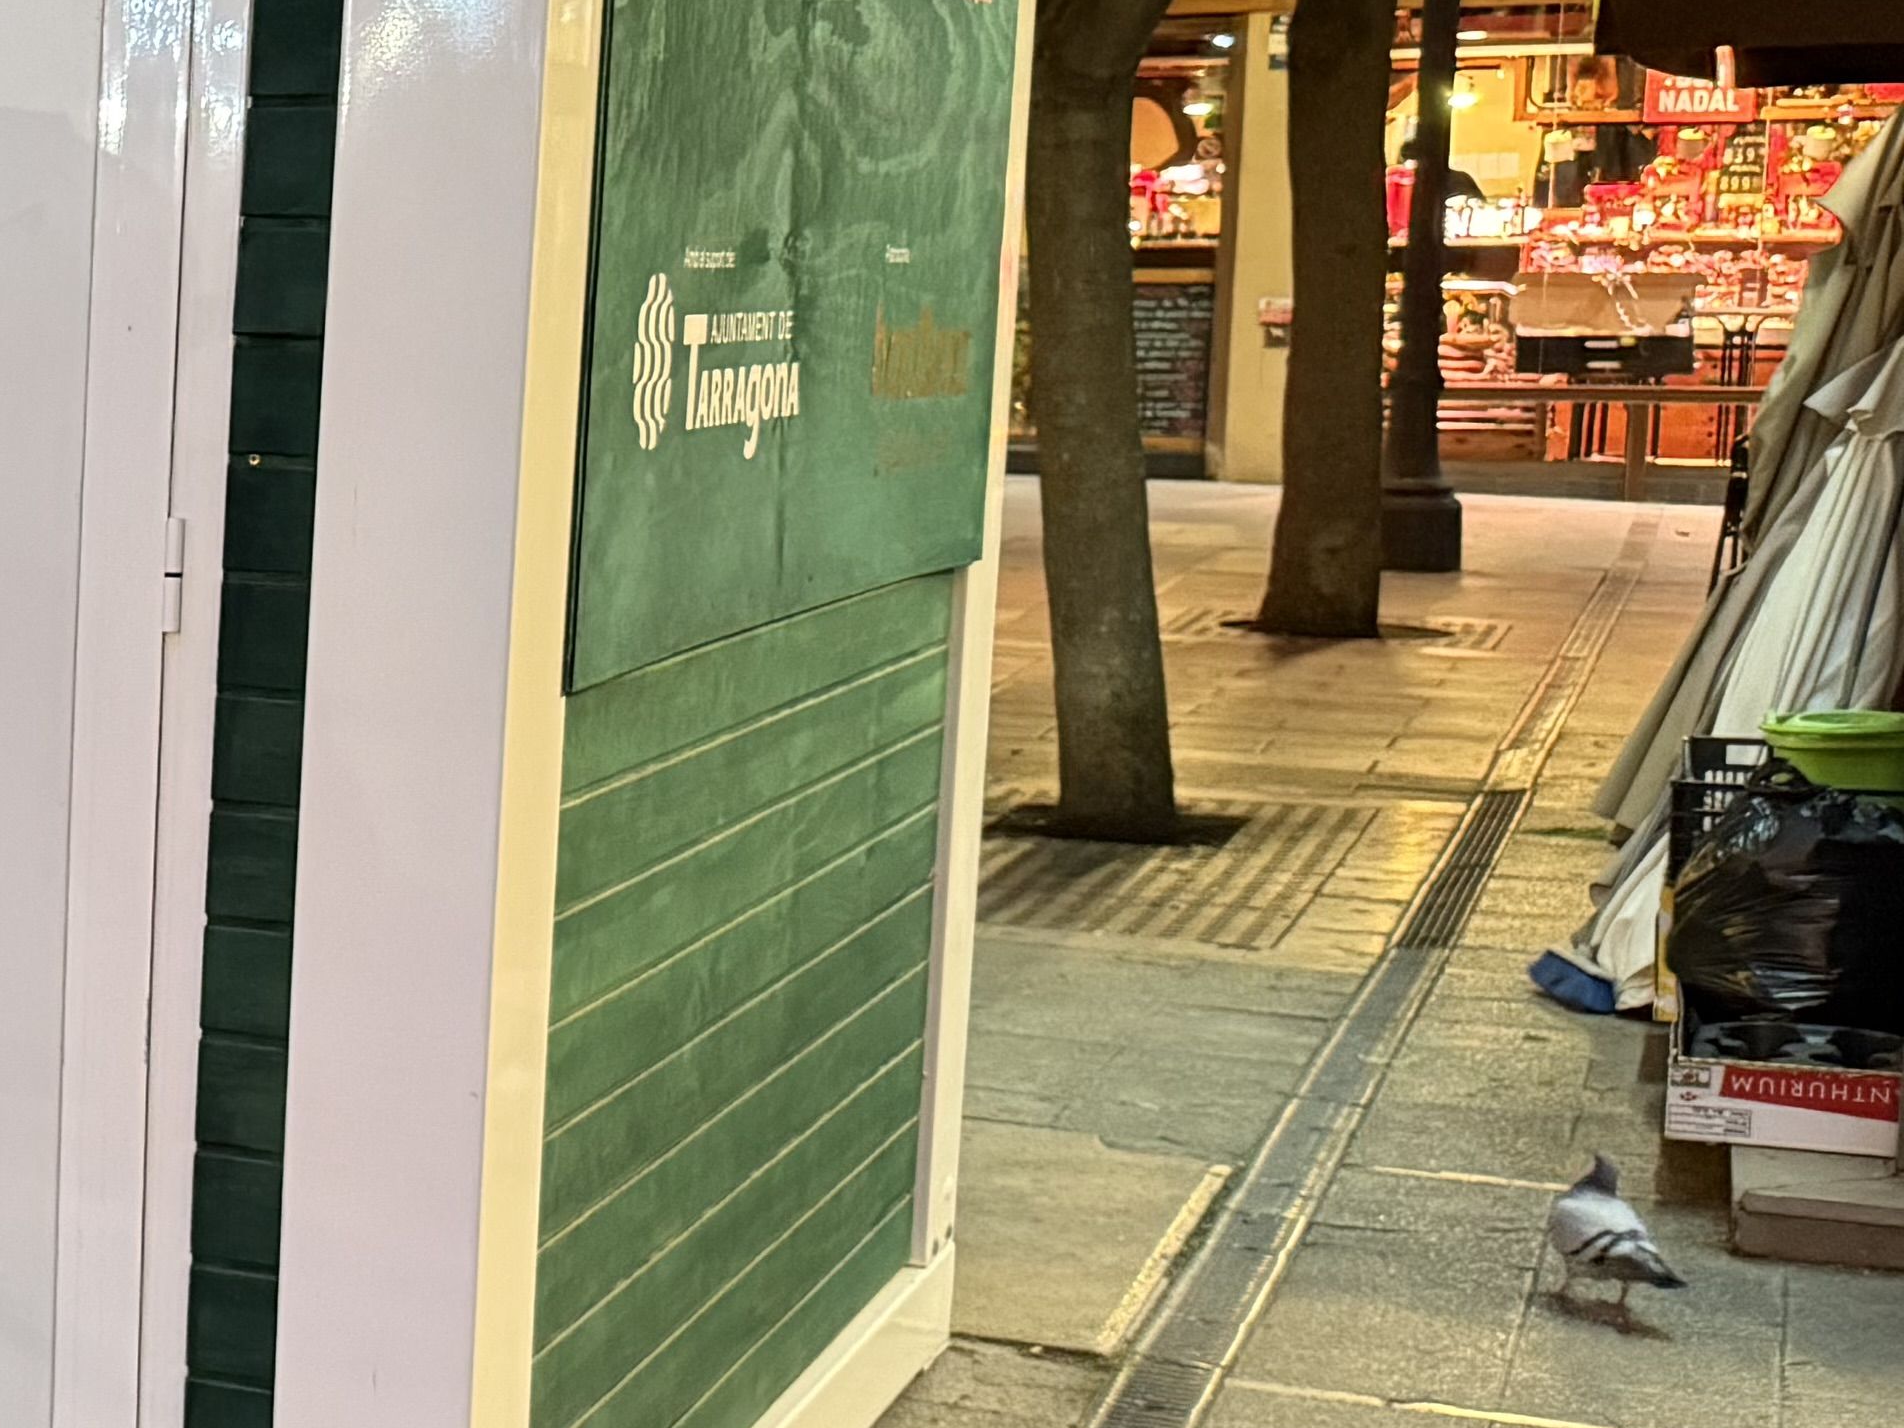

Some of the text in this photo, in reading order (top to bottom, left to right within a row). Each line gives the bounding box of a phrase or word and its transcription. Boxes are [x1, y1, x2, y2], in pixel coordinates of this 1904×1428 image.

[1658, 89, 1739, 113] NADAL
[710, 311, 777, 345] AJUNTAMENT
[1732, 1074, 1891, 1104] NTHURIUM
